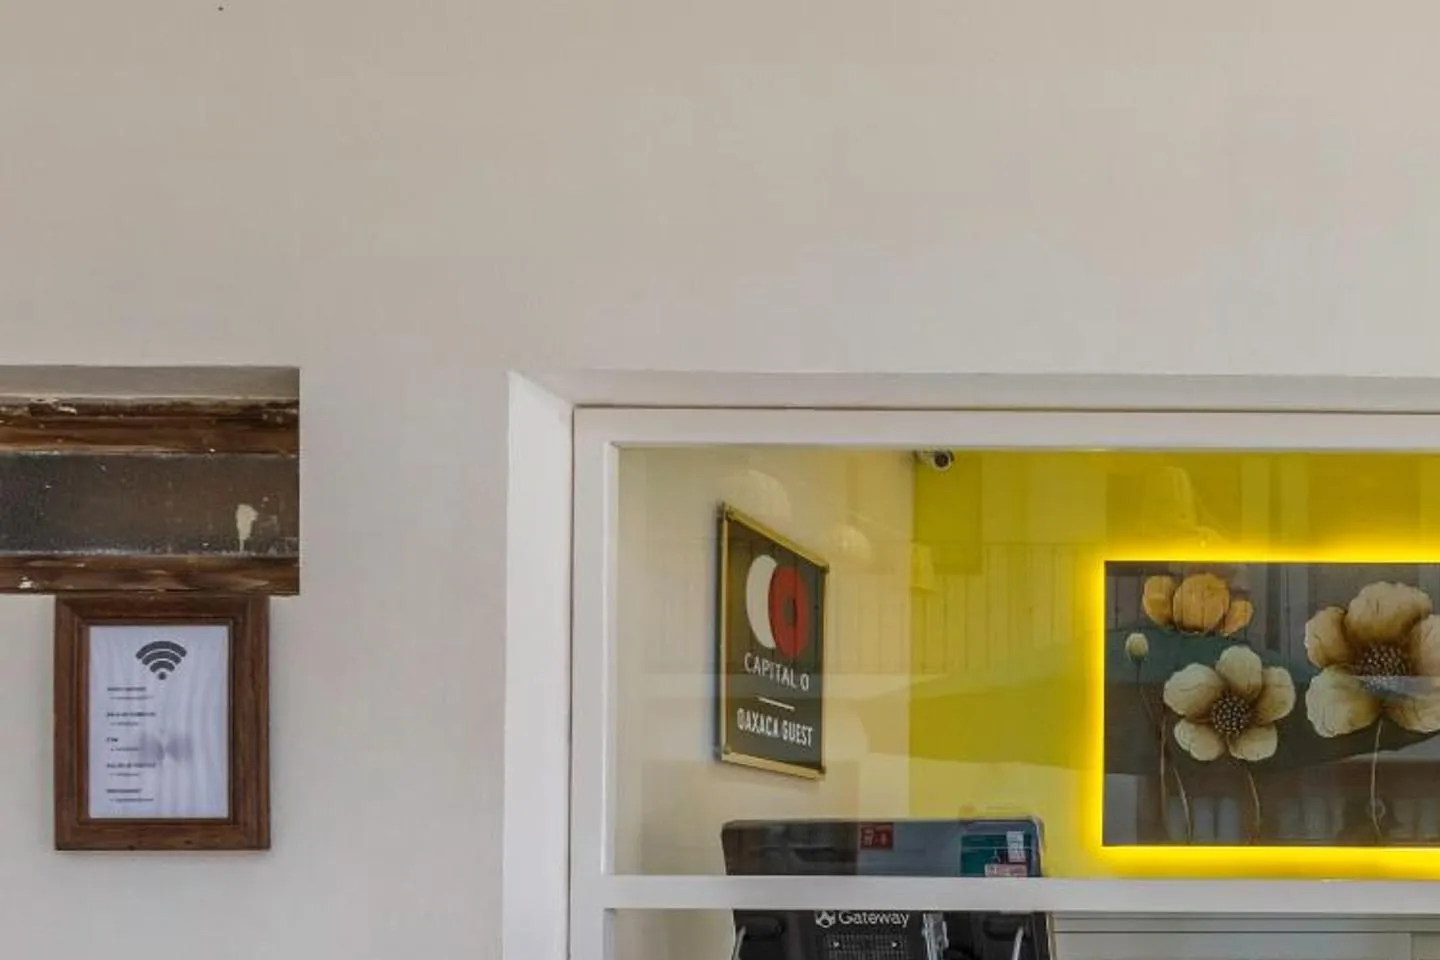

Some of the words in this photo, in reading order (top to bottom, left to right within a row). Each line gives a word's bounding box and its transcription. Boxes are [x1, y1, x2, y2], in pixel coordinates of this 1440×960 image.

[744, 651, 798, 690] CAPITAL
[800, 672, 810, 692] O
[736, 707, 779, 738] OAXACA
[781, 719, 813, 747] GUEST
[838, 911, 909, 928] Gateway
